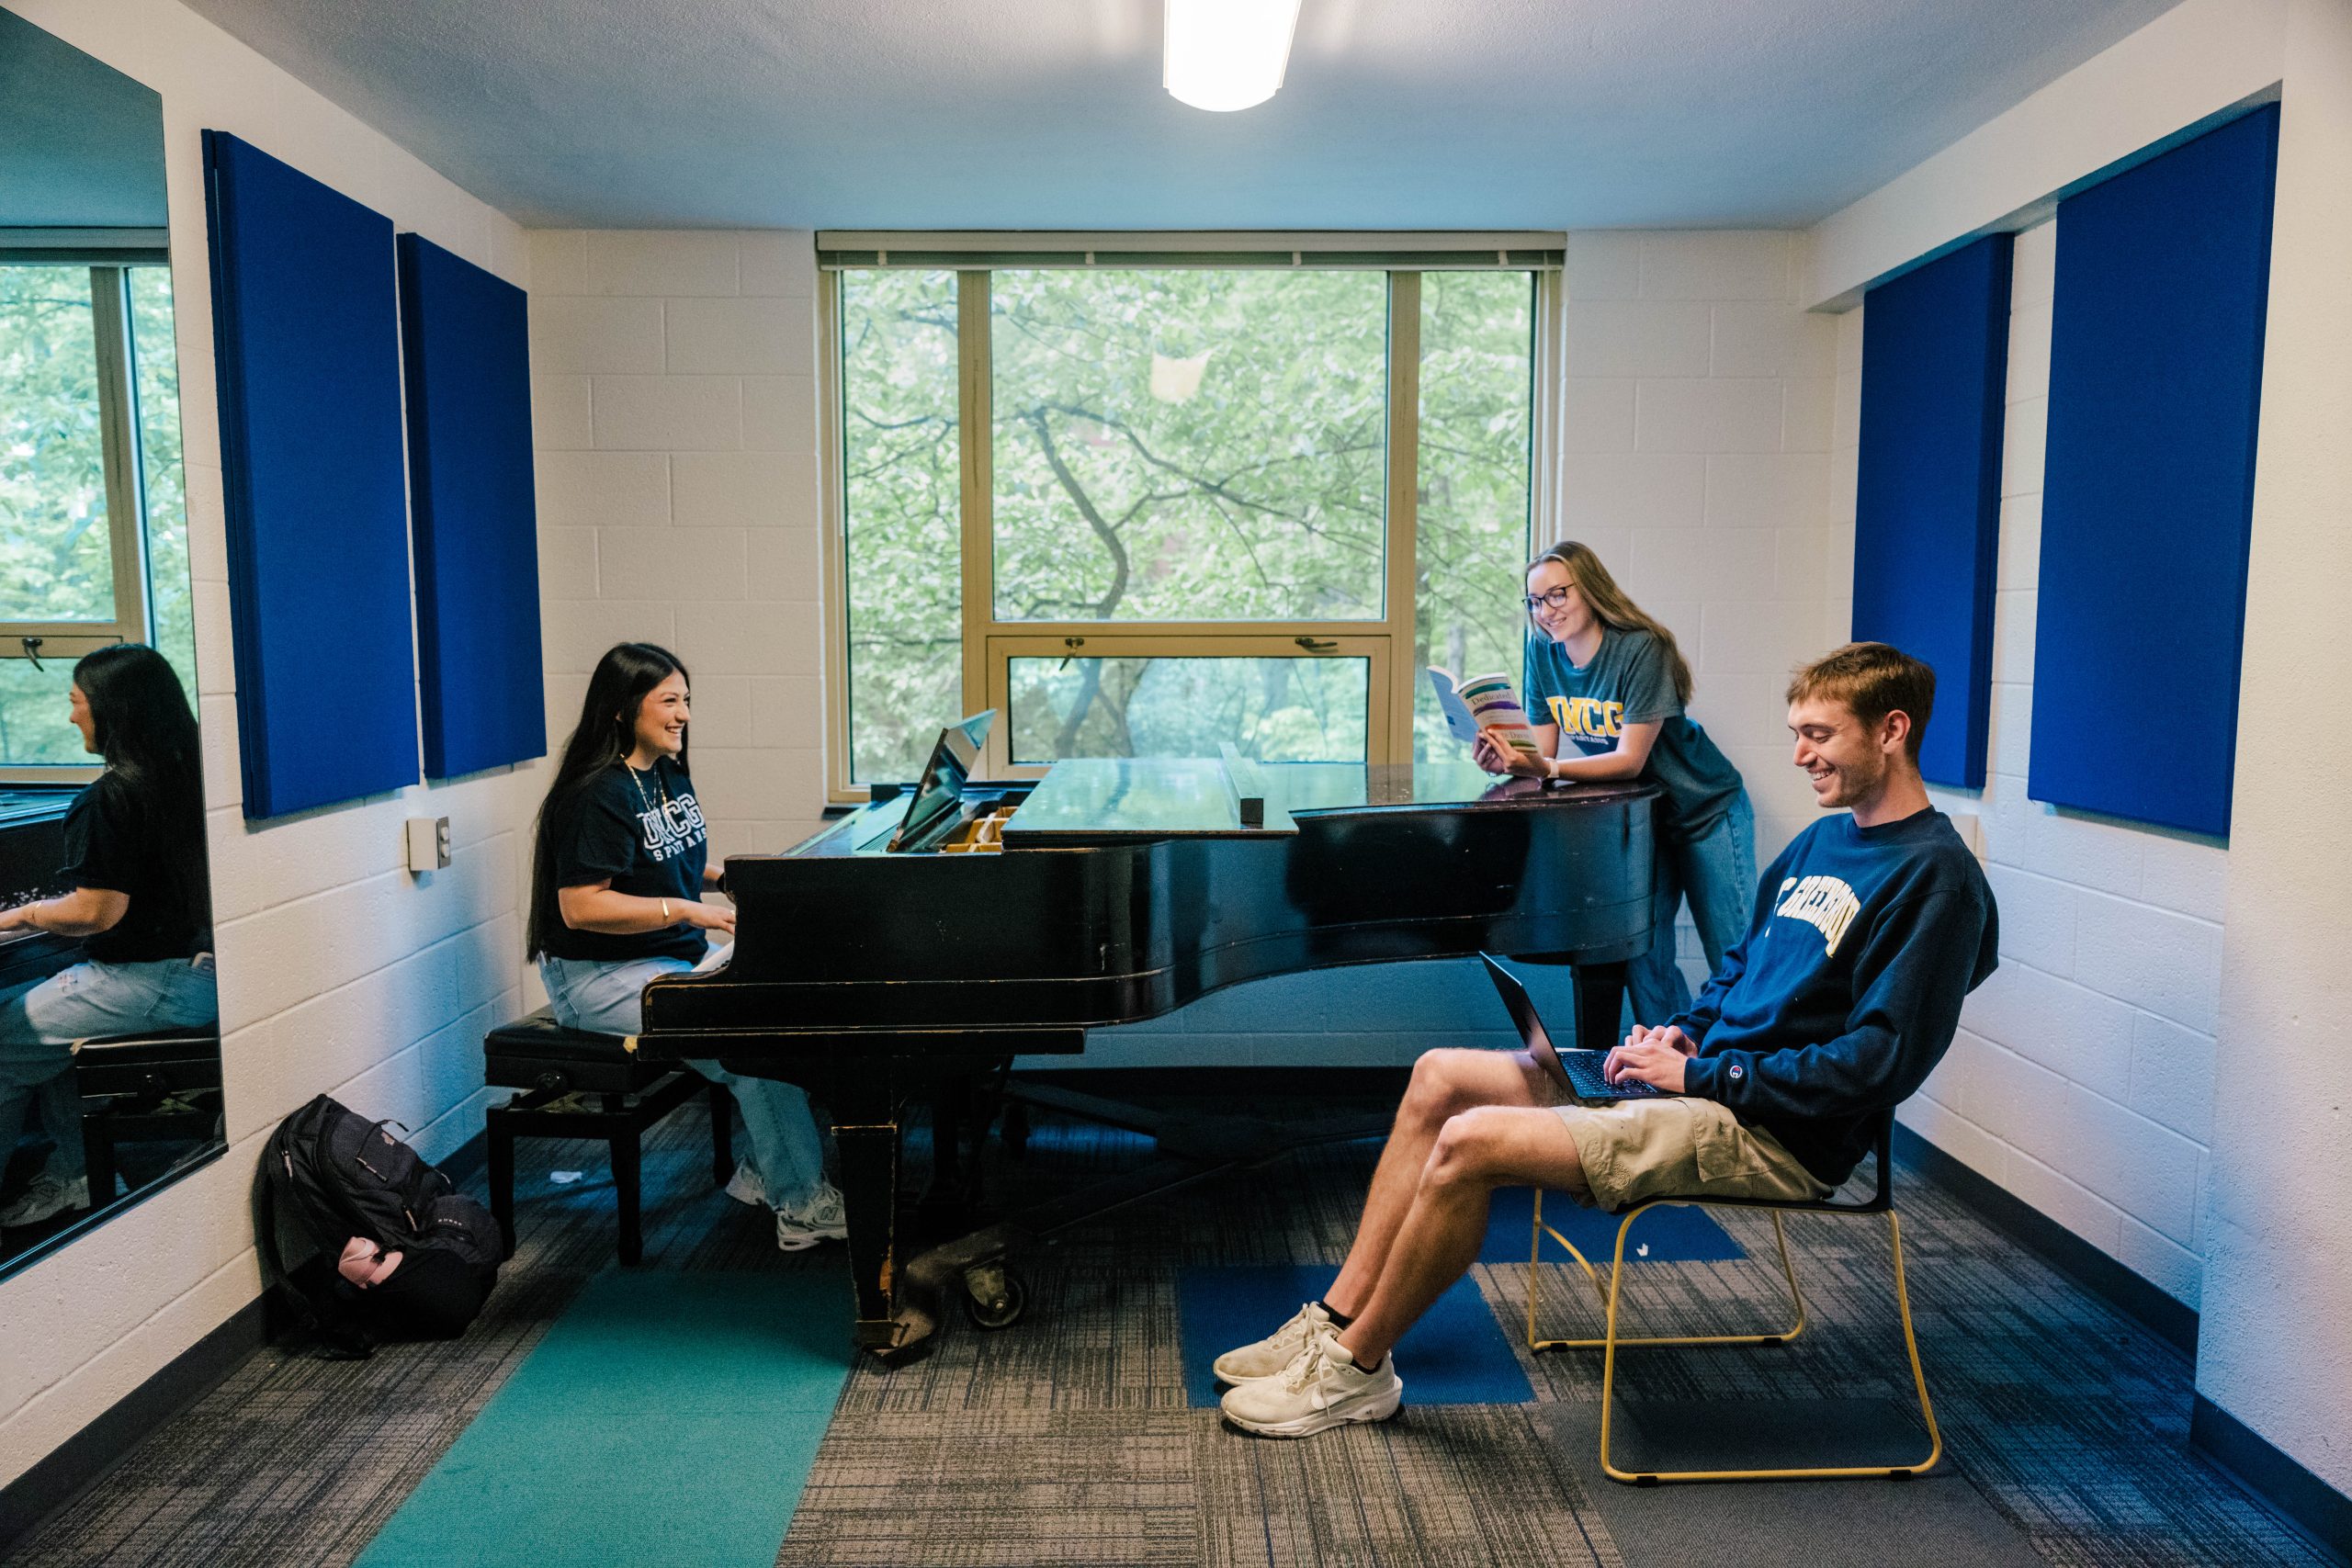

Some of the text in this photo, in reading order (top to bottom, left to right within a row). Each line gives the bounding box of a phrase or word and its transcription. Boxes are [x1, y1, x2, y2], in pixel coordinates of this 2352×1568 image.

[1471, 692, 1511, 705] Dedicated
[1571, 734, 1610, 745] PARTANS
[636, 793, 705, 850] UNCG
[653, 827, 707, 862] SPTANS
